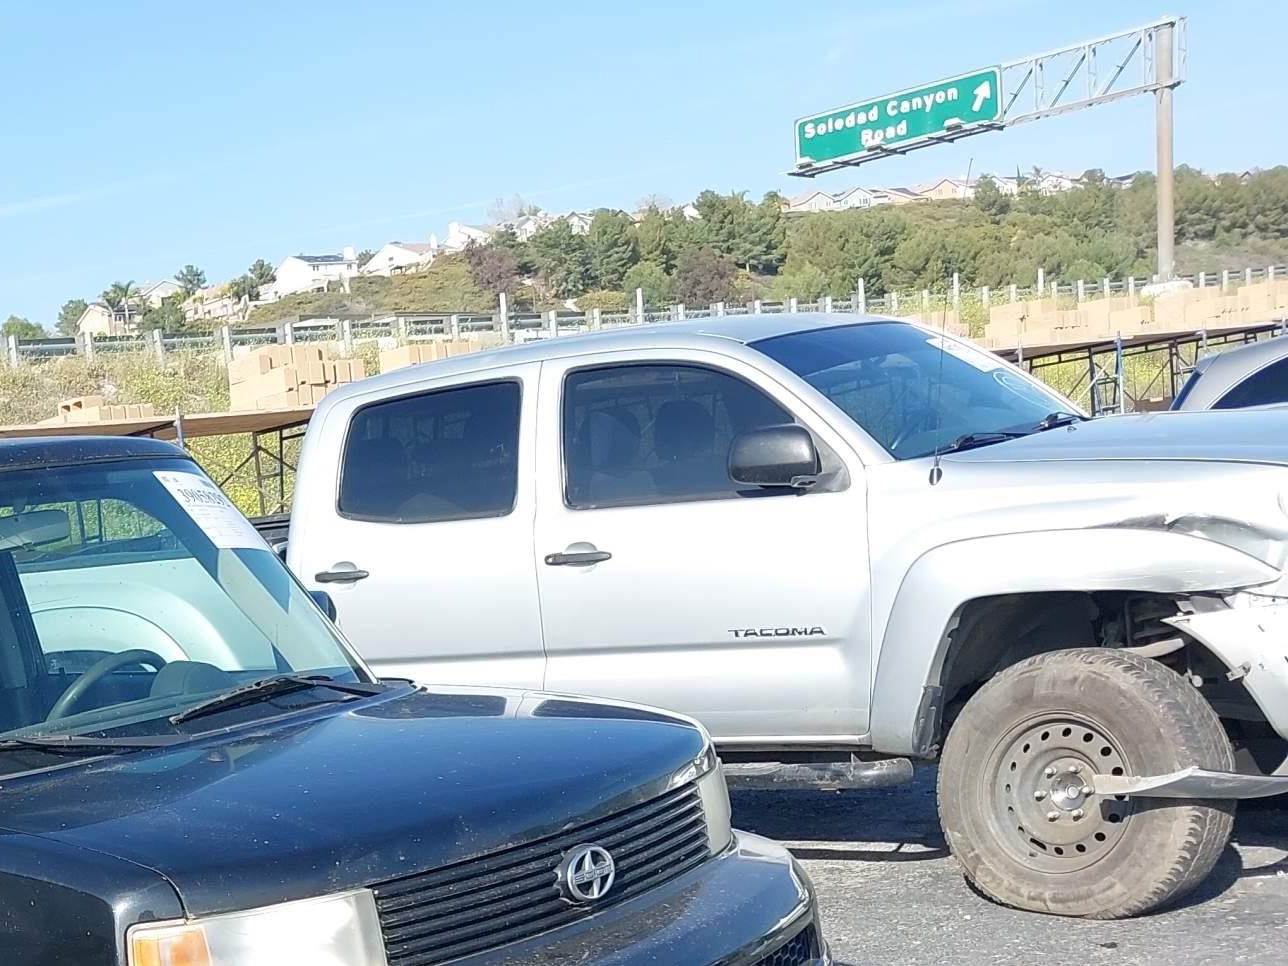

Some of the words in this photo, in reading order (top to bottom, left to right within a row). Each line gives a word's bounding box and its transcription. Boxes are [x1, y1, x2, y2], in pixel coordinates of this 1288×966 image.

[804, 105, 879, 139] Soledad
[886, 86, 960, 117] Canyon
[860, 119, 908, 147] Road
[727, 626, 825, 638] TACOMA
